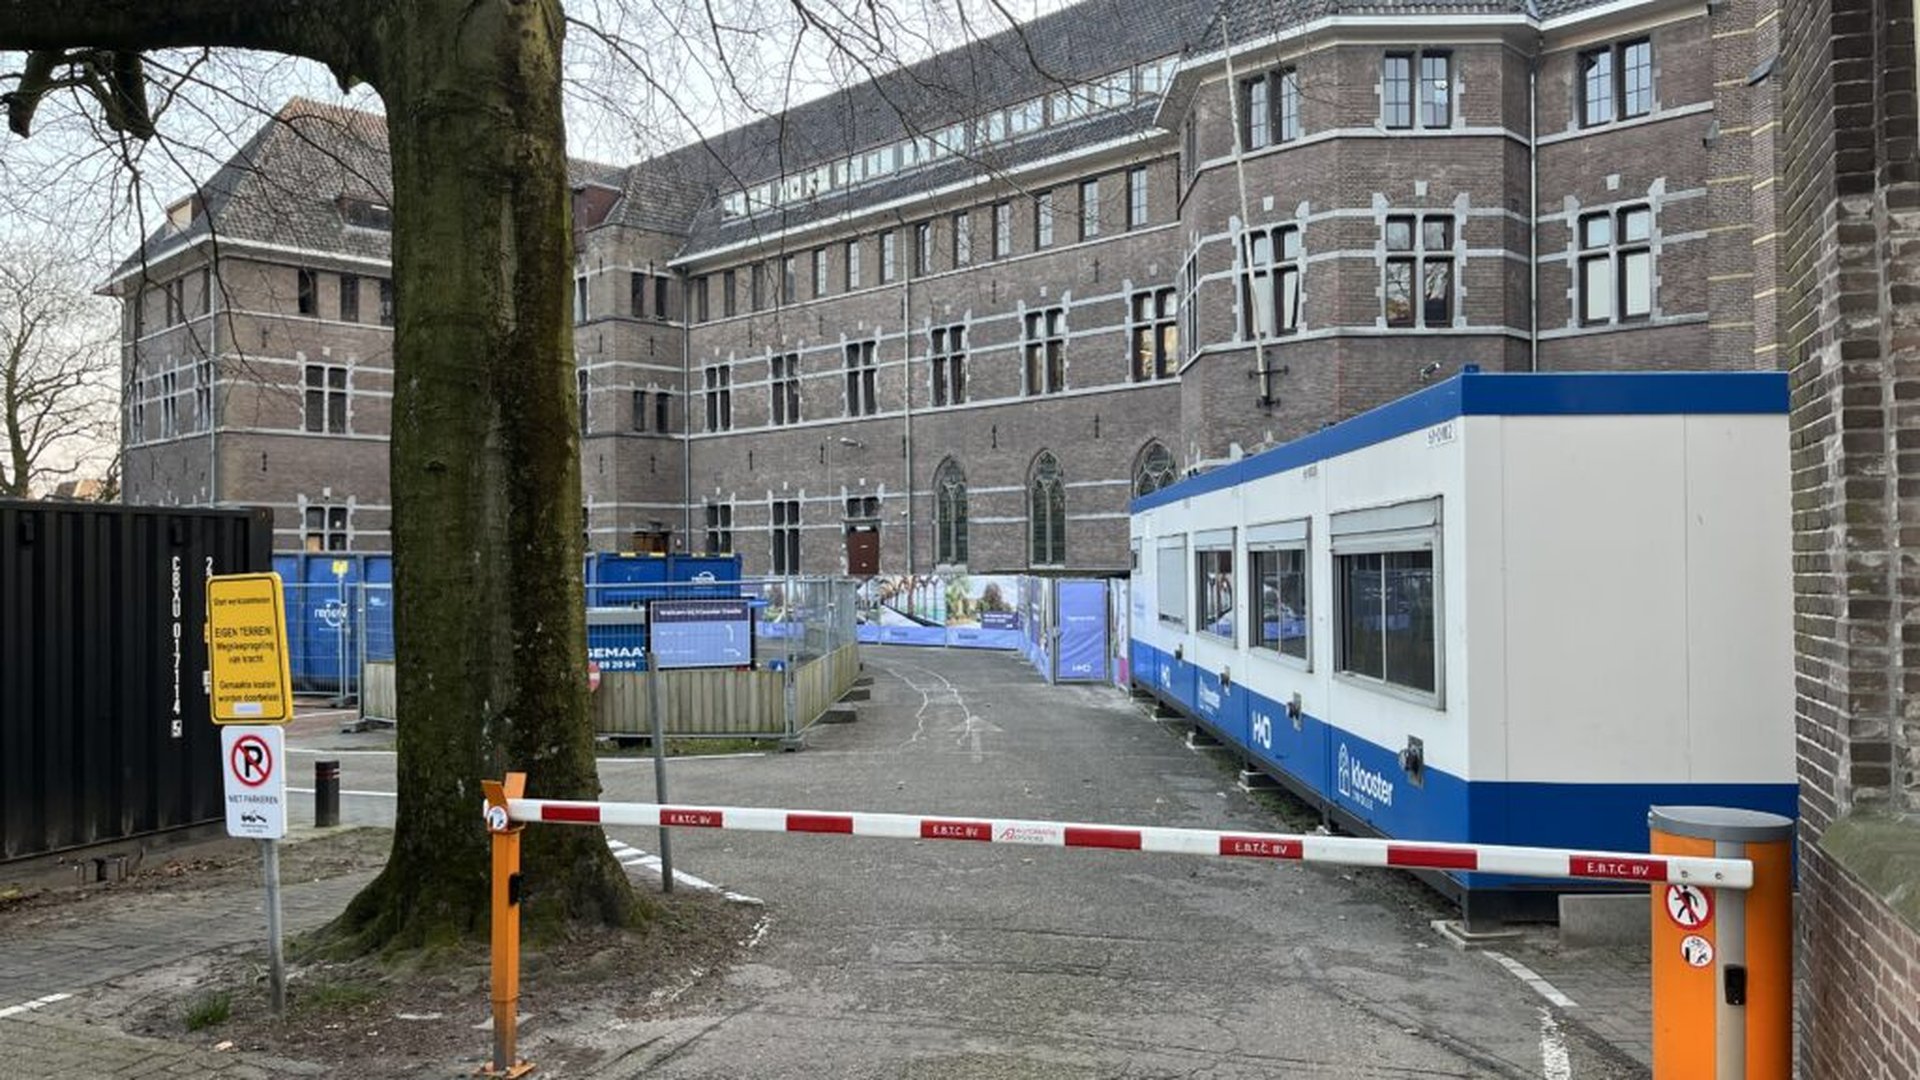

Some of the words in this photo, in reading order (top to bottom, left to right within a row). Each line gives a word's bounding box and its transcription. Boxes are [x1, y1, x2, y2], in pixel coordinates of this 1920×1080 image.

[215, 627, 238, 638] EIGEN
[1351, 756, 1393, 807] klooster
[1272, 845, 1288, 855] BV
[1632, 865, 1650, 876] BV
